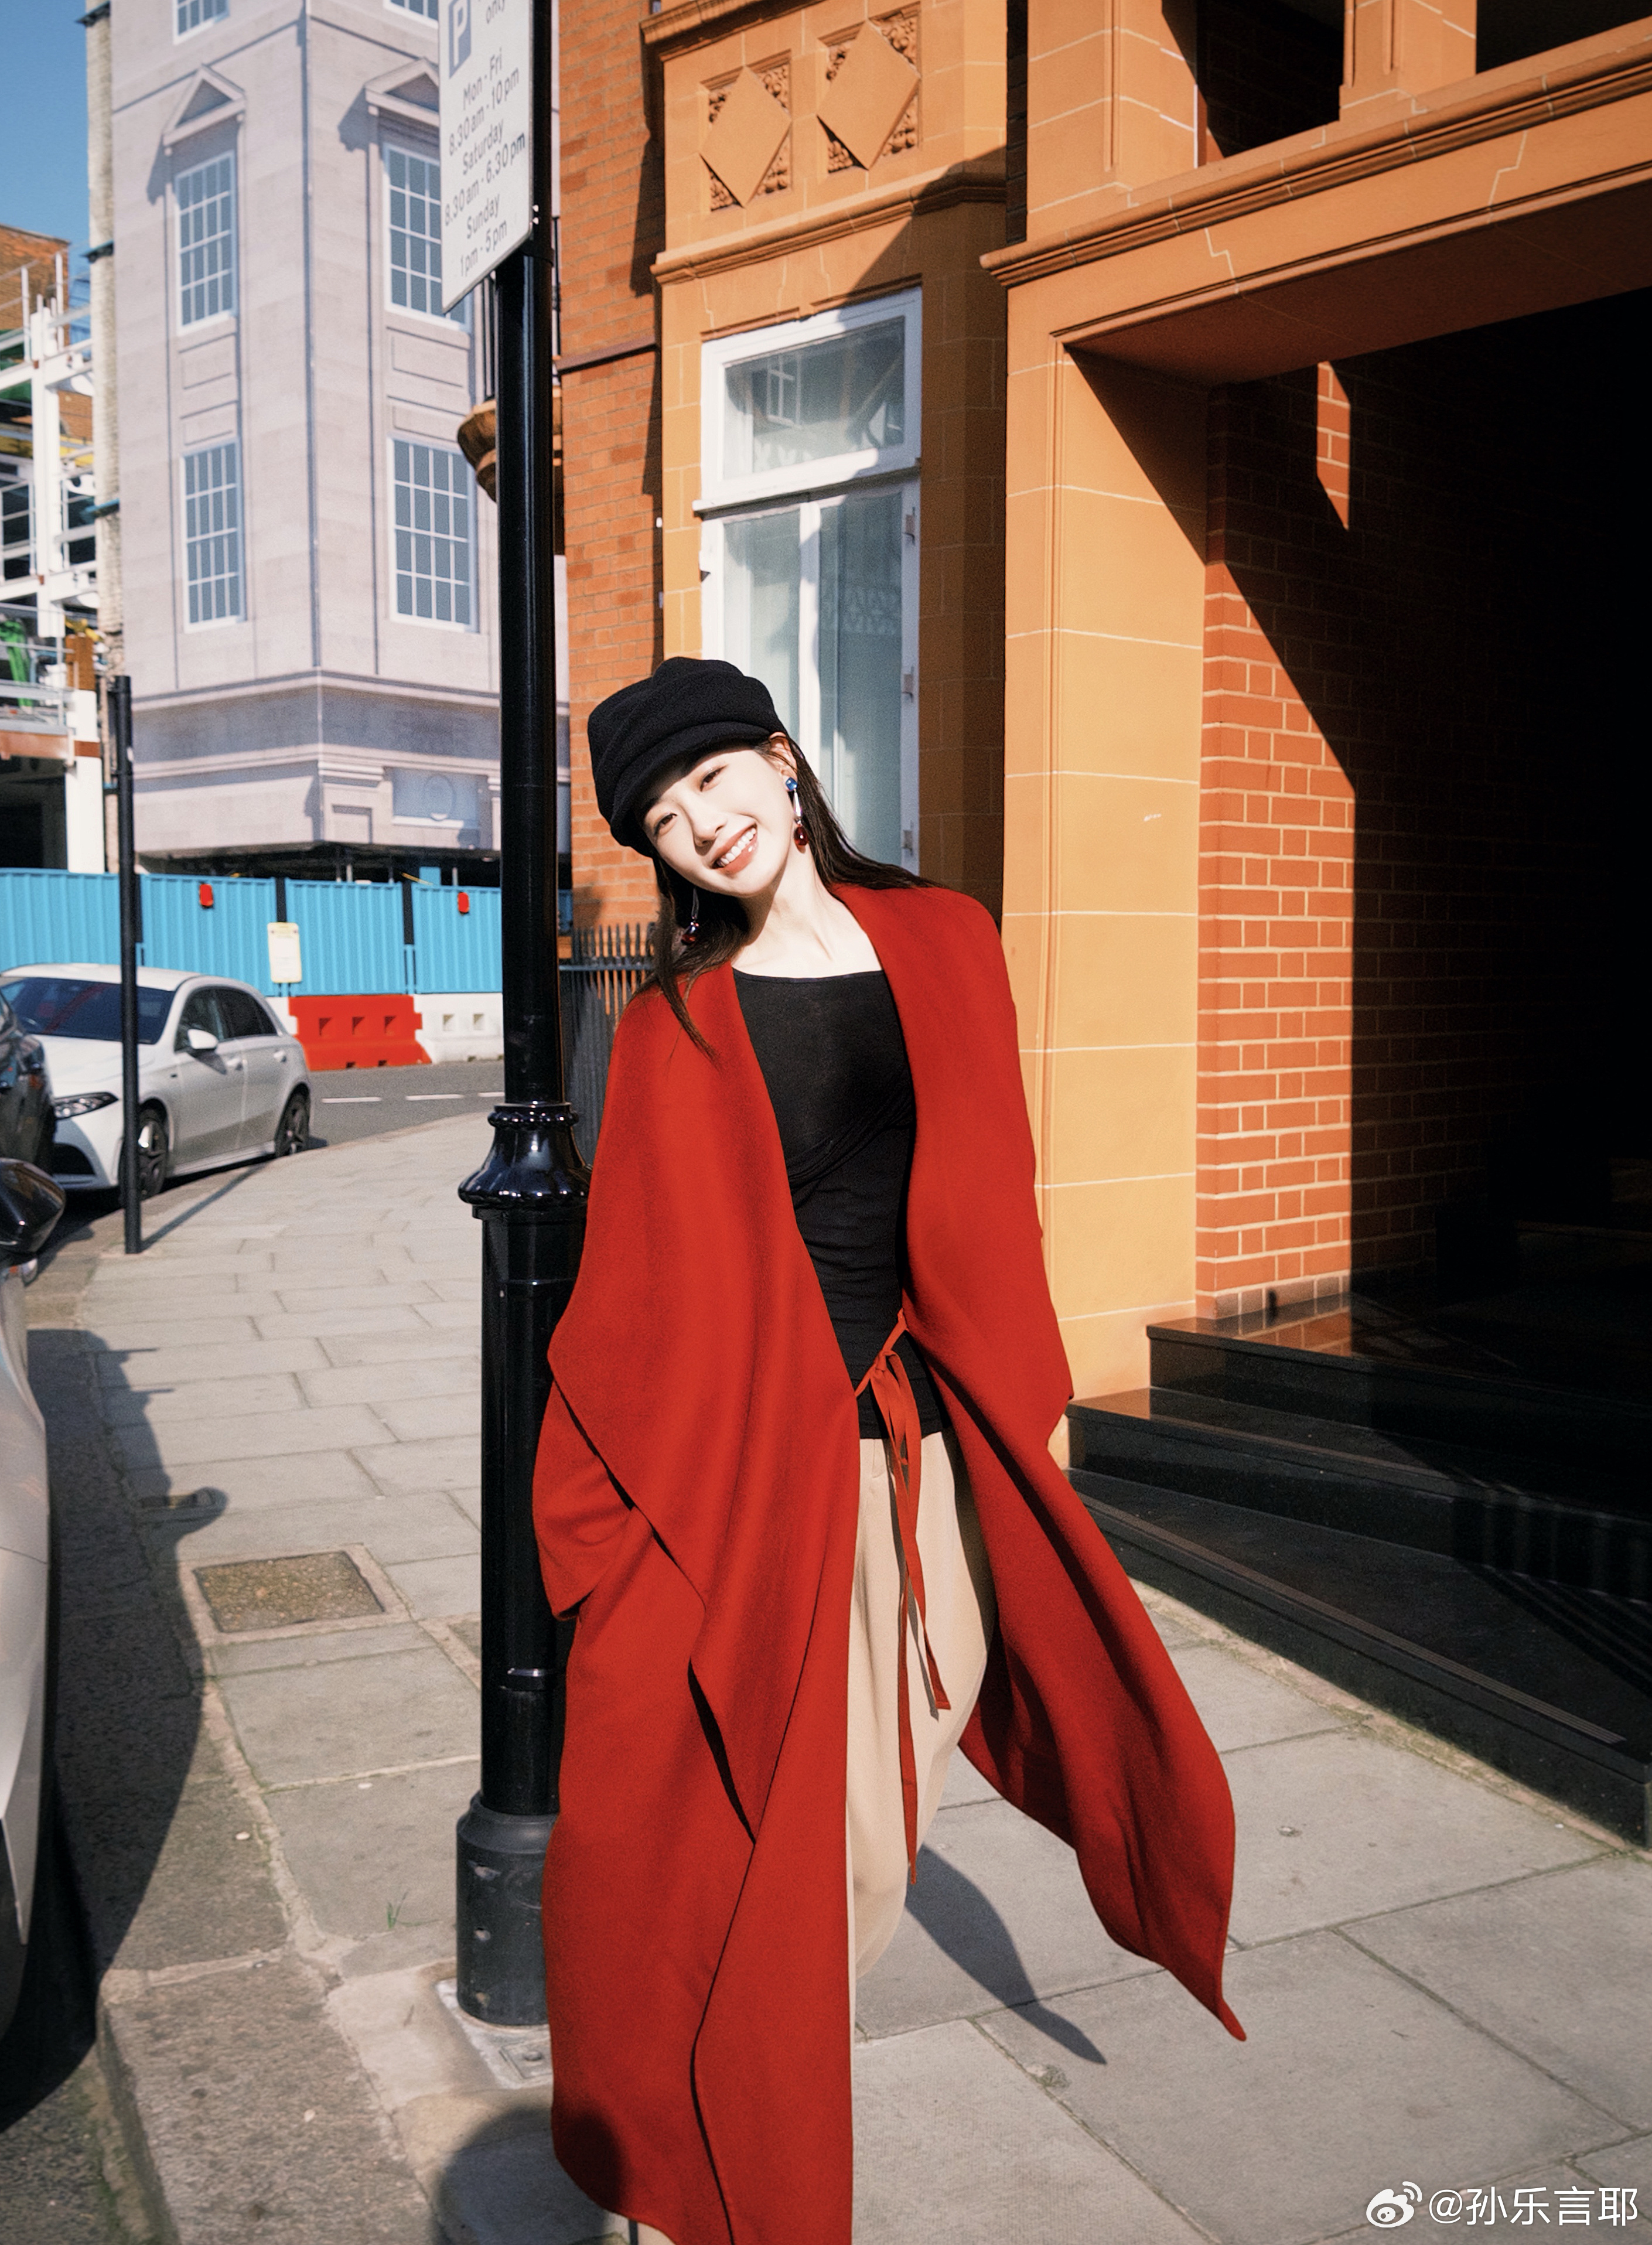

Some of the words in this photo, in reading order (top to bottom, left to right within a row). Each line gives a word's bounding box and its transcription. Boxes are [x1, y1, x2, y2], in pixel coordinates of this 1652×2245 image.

[463, 77, 482, 110] Mon
[490, 47, 502, 81] Fri
[462, 118, 504, 176] Saturday
[466, 193, 500, 240] Sunday
